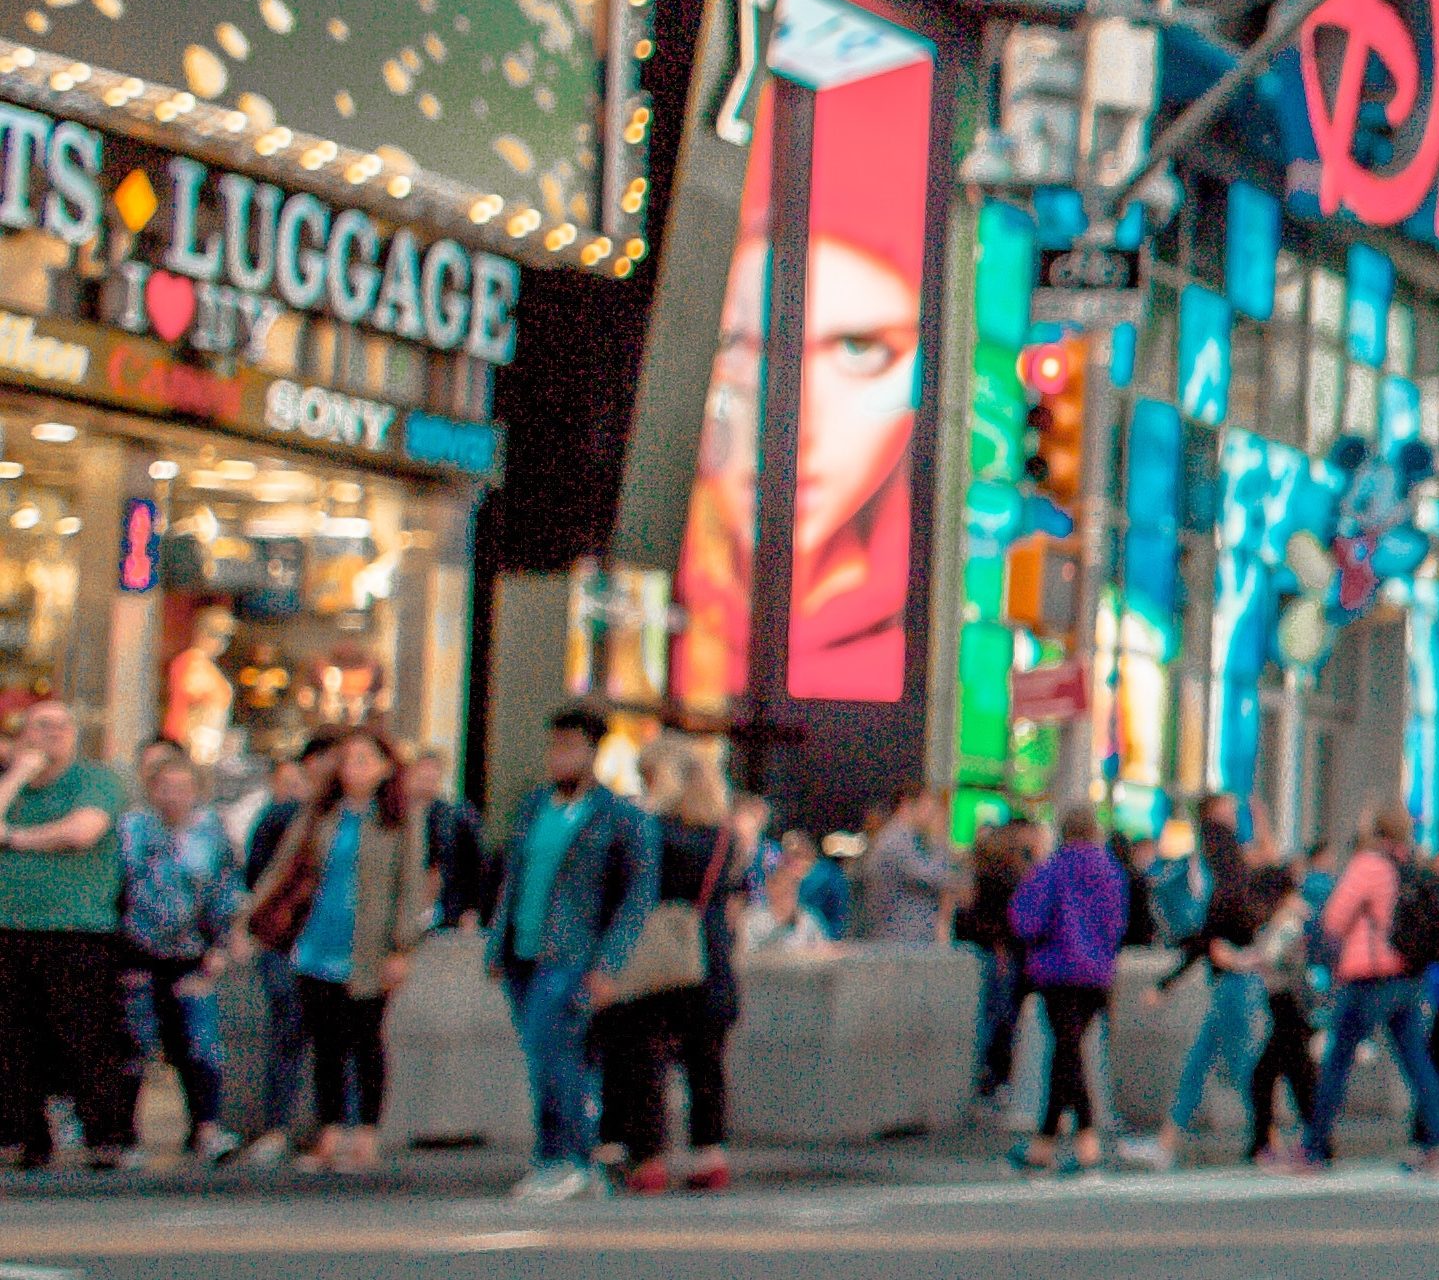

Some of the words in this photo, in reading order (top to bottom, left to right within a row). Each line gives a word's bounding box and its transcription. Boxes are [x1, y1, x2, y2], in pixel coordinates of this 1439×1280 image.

[121, 261, 149, 331] I
[163, 156, 523, 366] LUGGAGE
[264, 377, 397, 451] SONY
